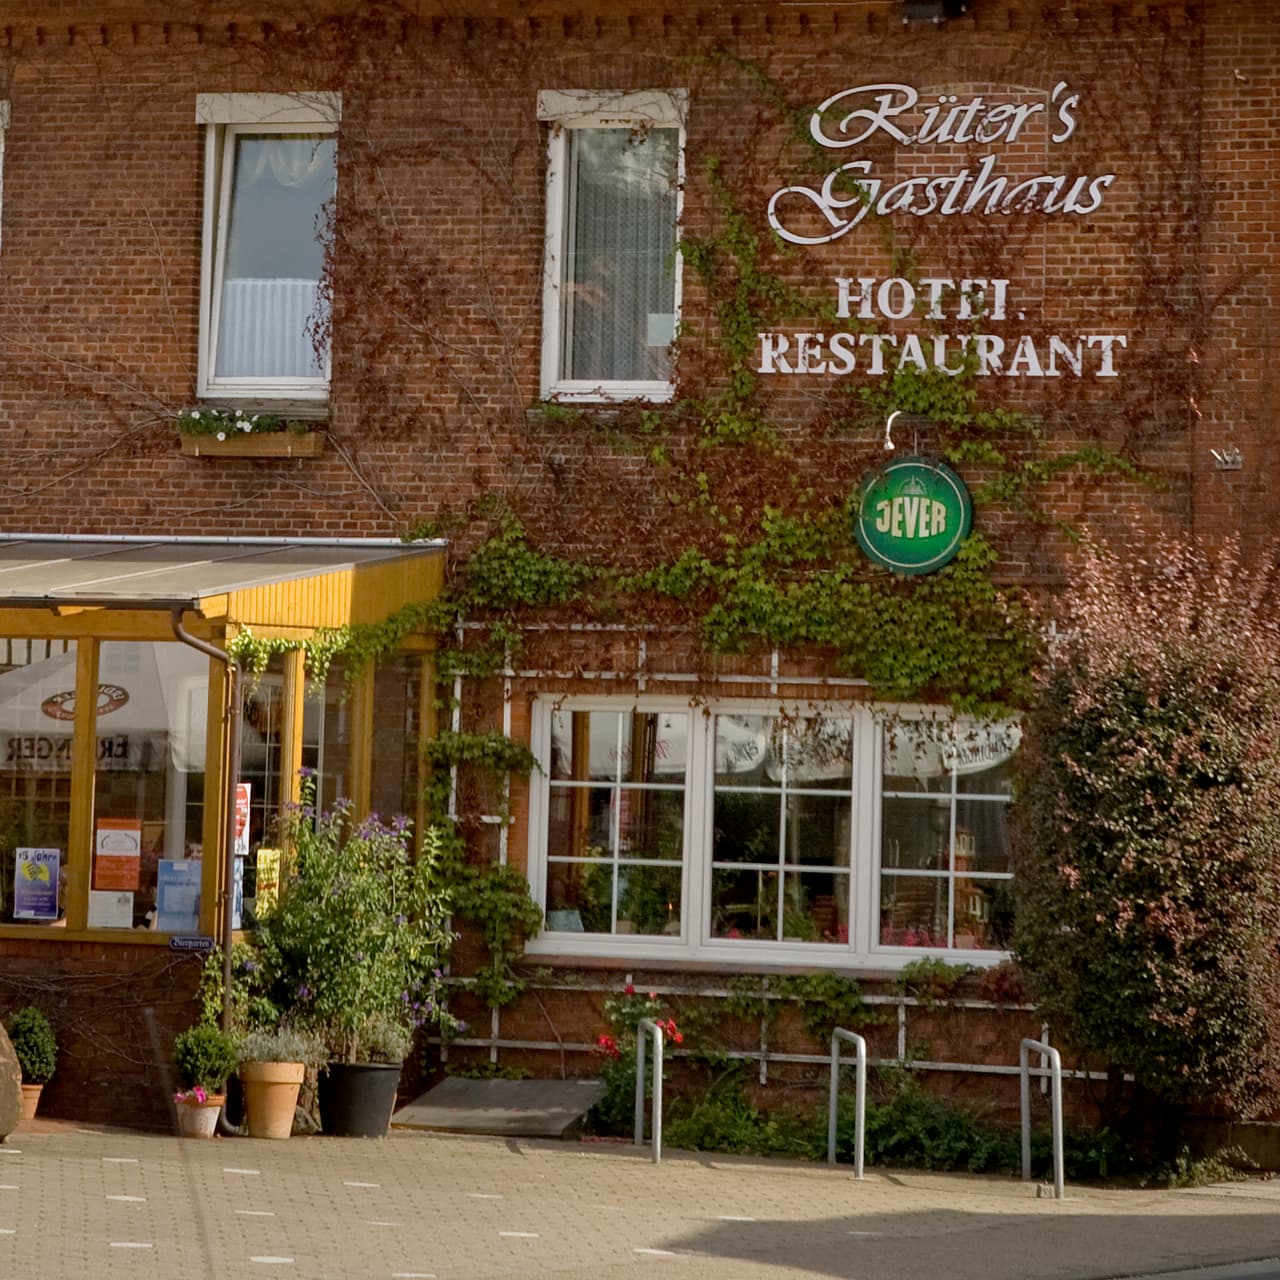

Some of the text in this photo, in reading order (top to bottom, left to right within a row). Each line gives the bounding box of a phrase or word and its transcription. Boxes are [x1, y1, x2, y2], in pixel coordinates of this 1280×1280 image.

[810, 81, 1080, 148] Rüter's
[768, 154, 1116, 245] Gasthaus
[835, 277, 1027, 320] HOTEL
[757, 332, 1127, 377] RESTAURANT
[875, 496, 946, 538] JEVER
